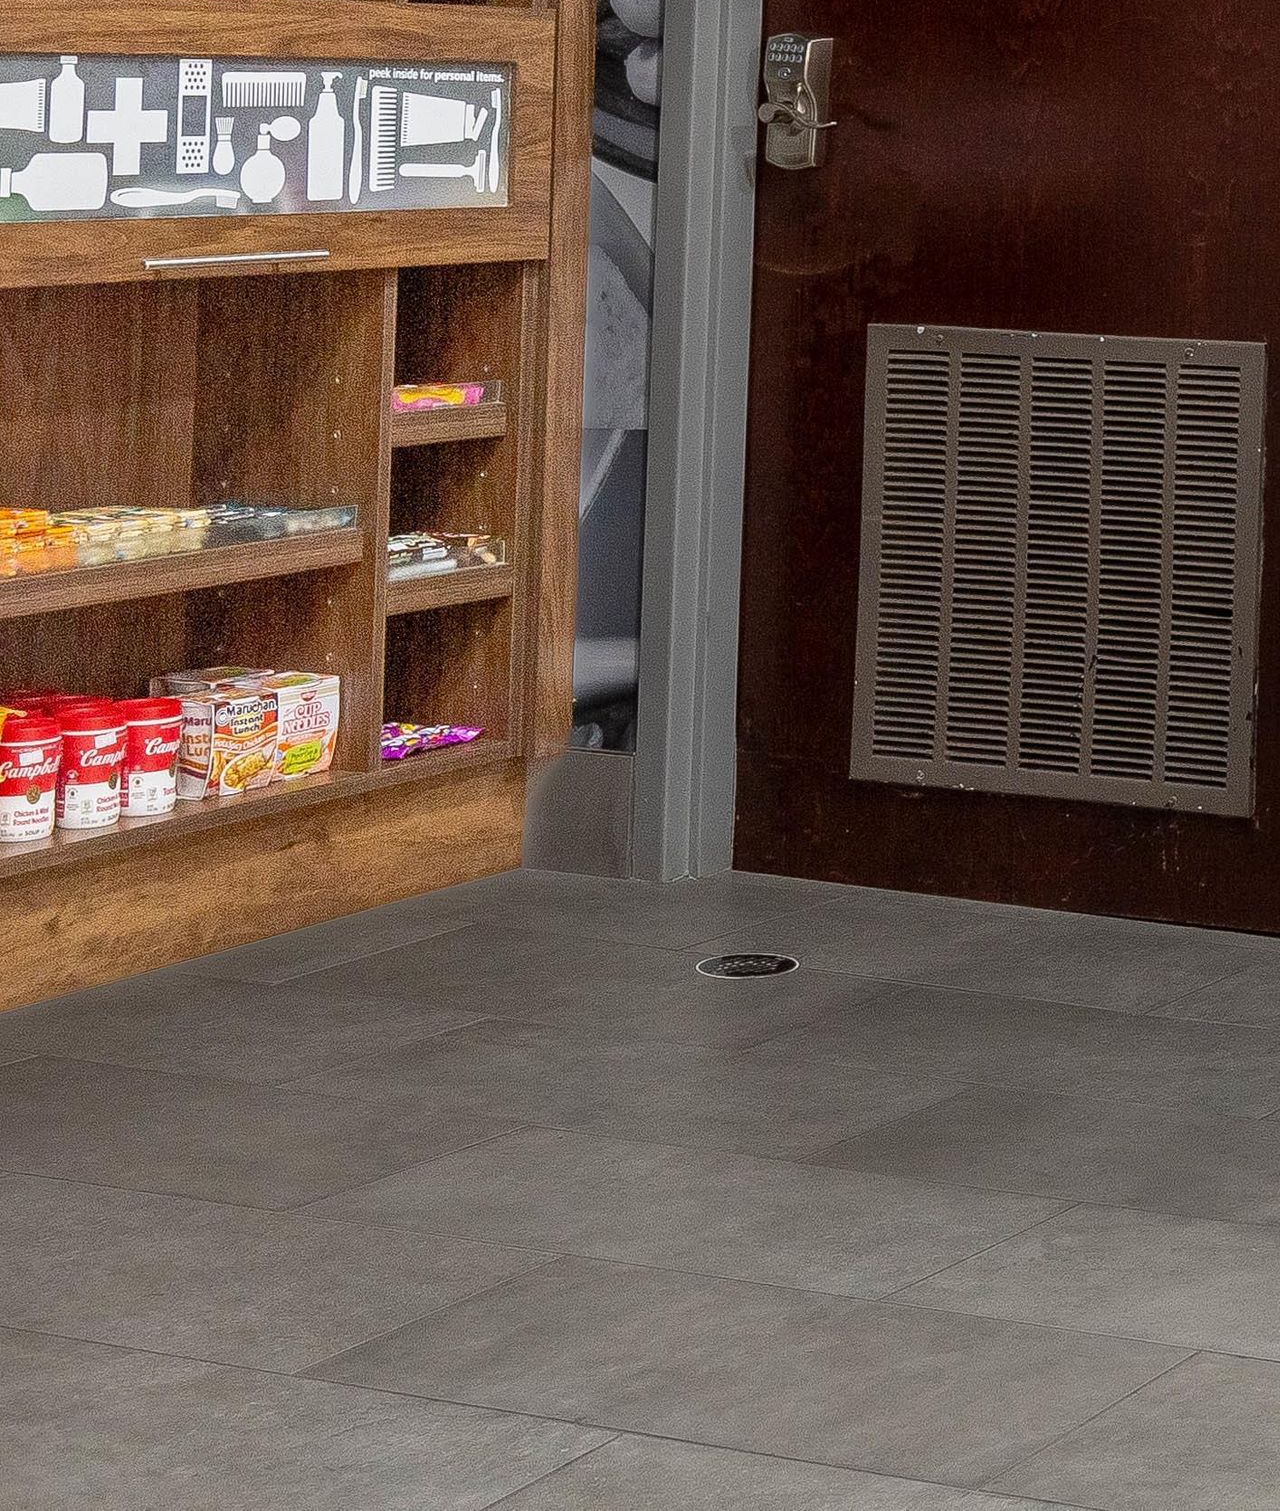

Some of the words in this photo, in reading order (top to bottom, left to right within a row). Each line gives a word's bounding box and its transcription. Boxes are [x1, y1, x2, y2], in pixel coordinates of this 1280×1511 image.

[369, 68, 391, 80] peek
[393, 68, 419, 79] inside
[420, 68, 433, 80] for
[434, 71, 475, 83] personal
[227, 700, 275, 716] Maruchan
[295, 701, 322, 719] CUP
[230, 715, 263, 727] Instant
[282, 712, 331, 735] NOODLES
[234, 724, 260, 735] Lunch
